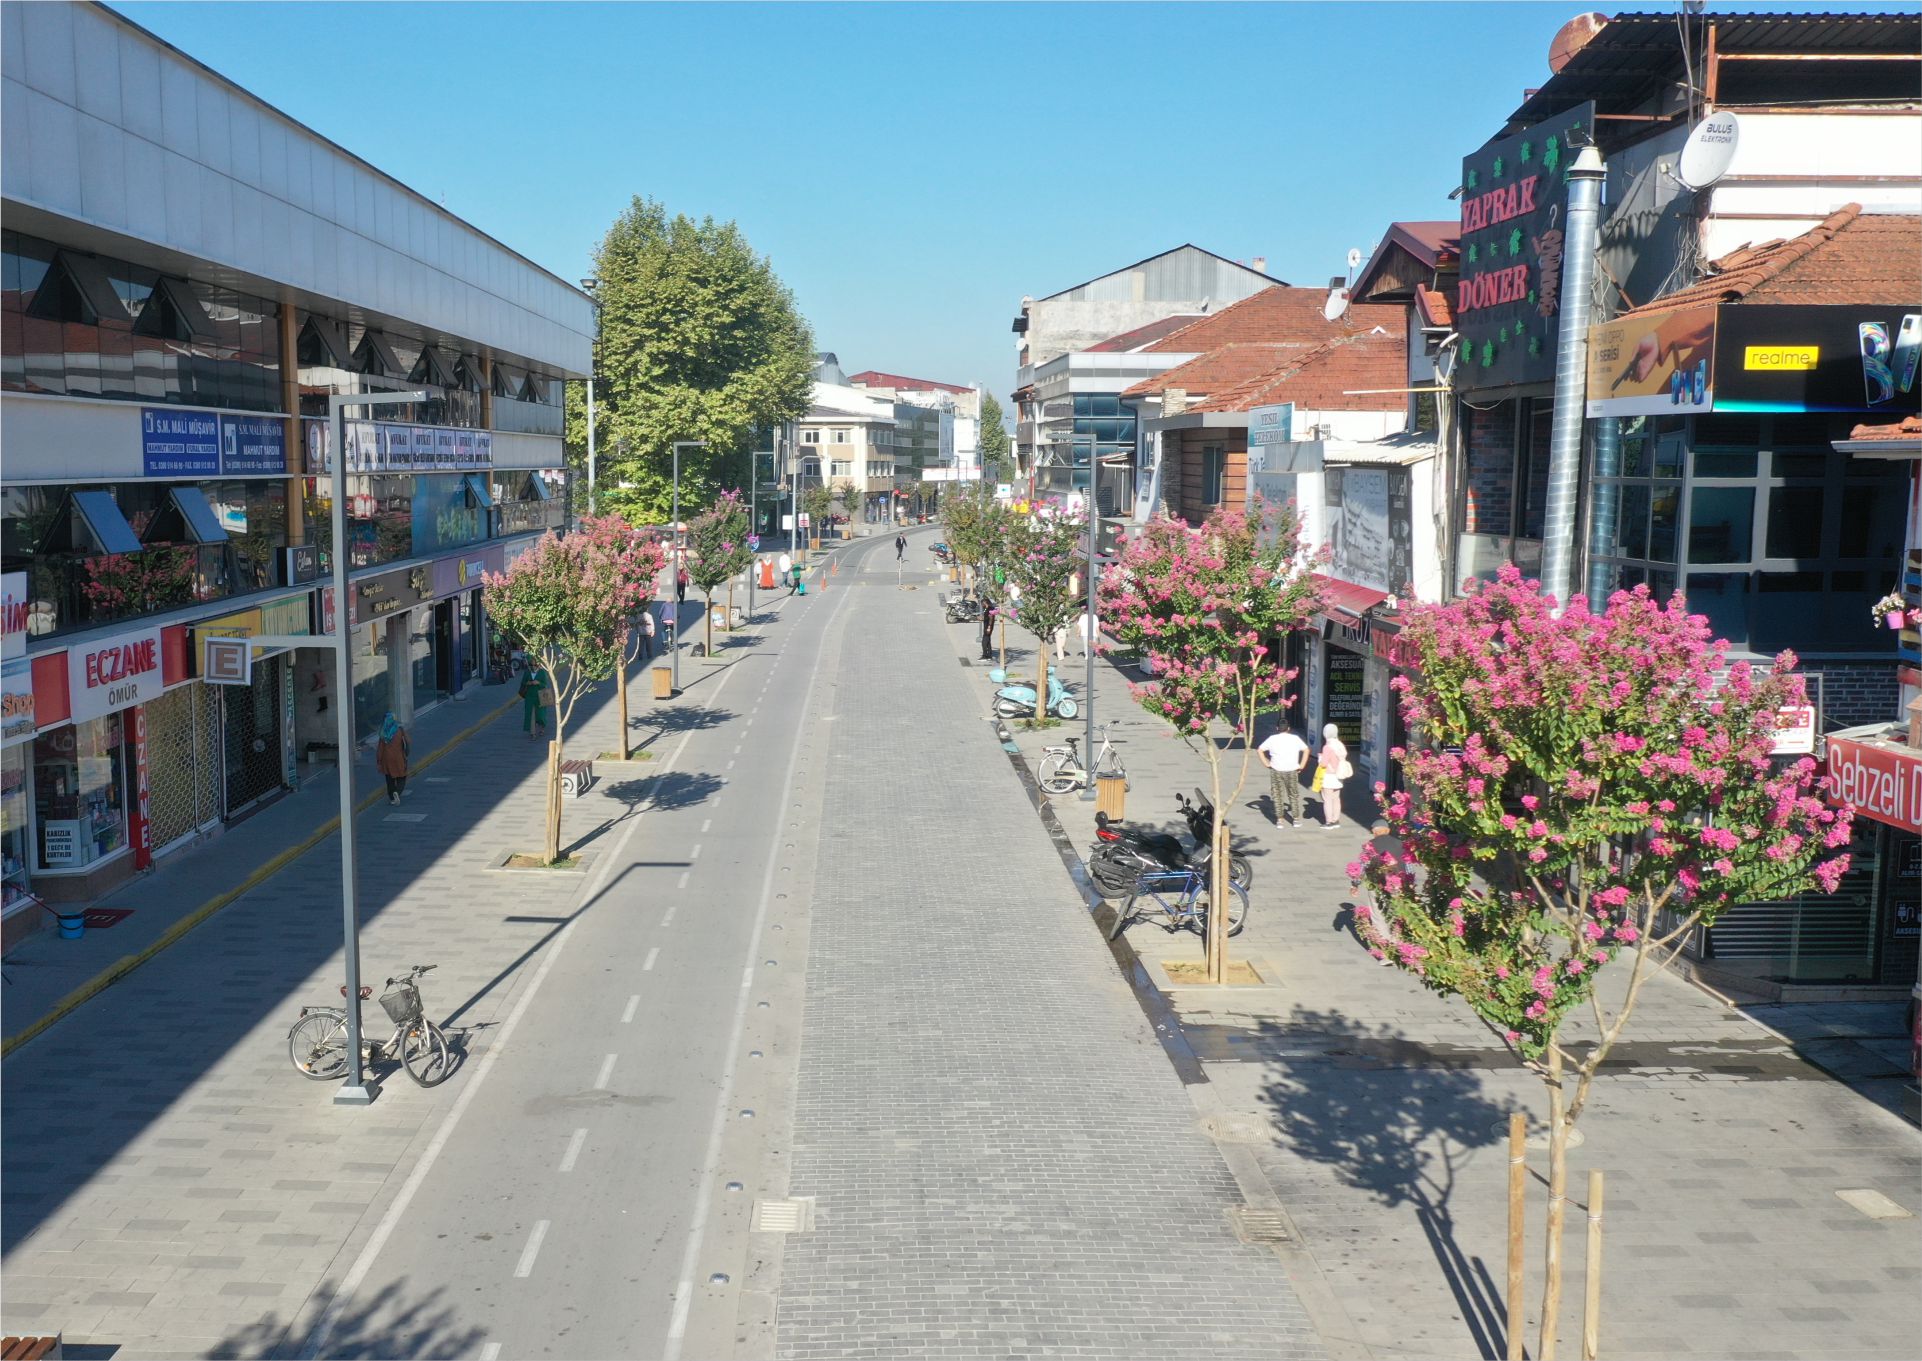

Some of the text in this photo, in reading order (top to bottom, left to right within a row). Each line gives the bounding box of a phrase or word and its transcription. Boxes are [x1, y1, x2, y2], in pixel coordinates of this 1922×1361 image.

[1461, 175, 1537, 234] YAPRAK
[1456, 264, 1528, 314] DÖNER
[1752, 351, 1810, 365] realme
[171, 417, 187, 434] MALİ
[86, 639, 157, 688] ECZANE
[216, 648, 238, 675] E
[109, 683, 138, 706] ÖMÜR
[1829, 744, 1905, 821] Sebzeli
